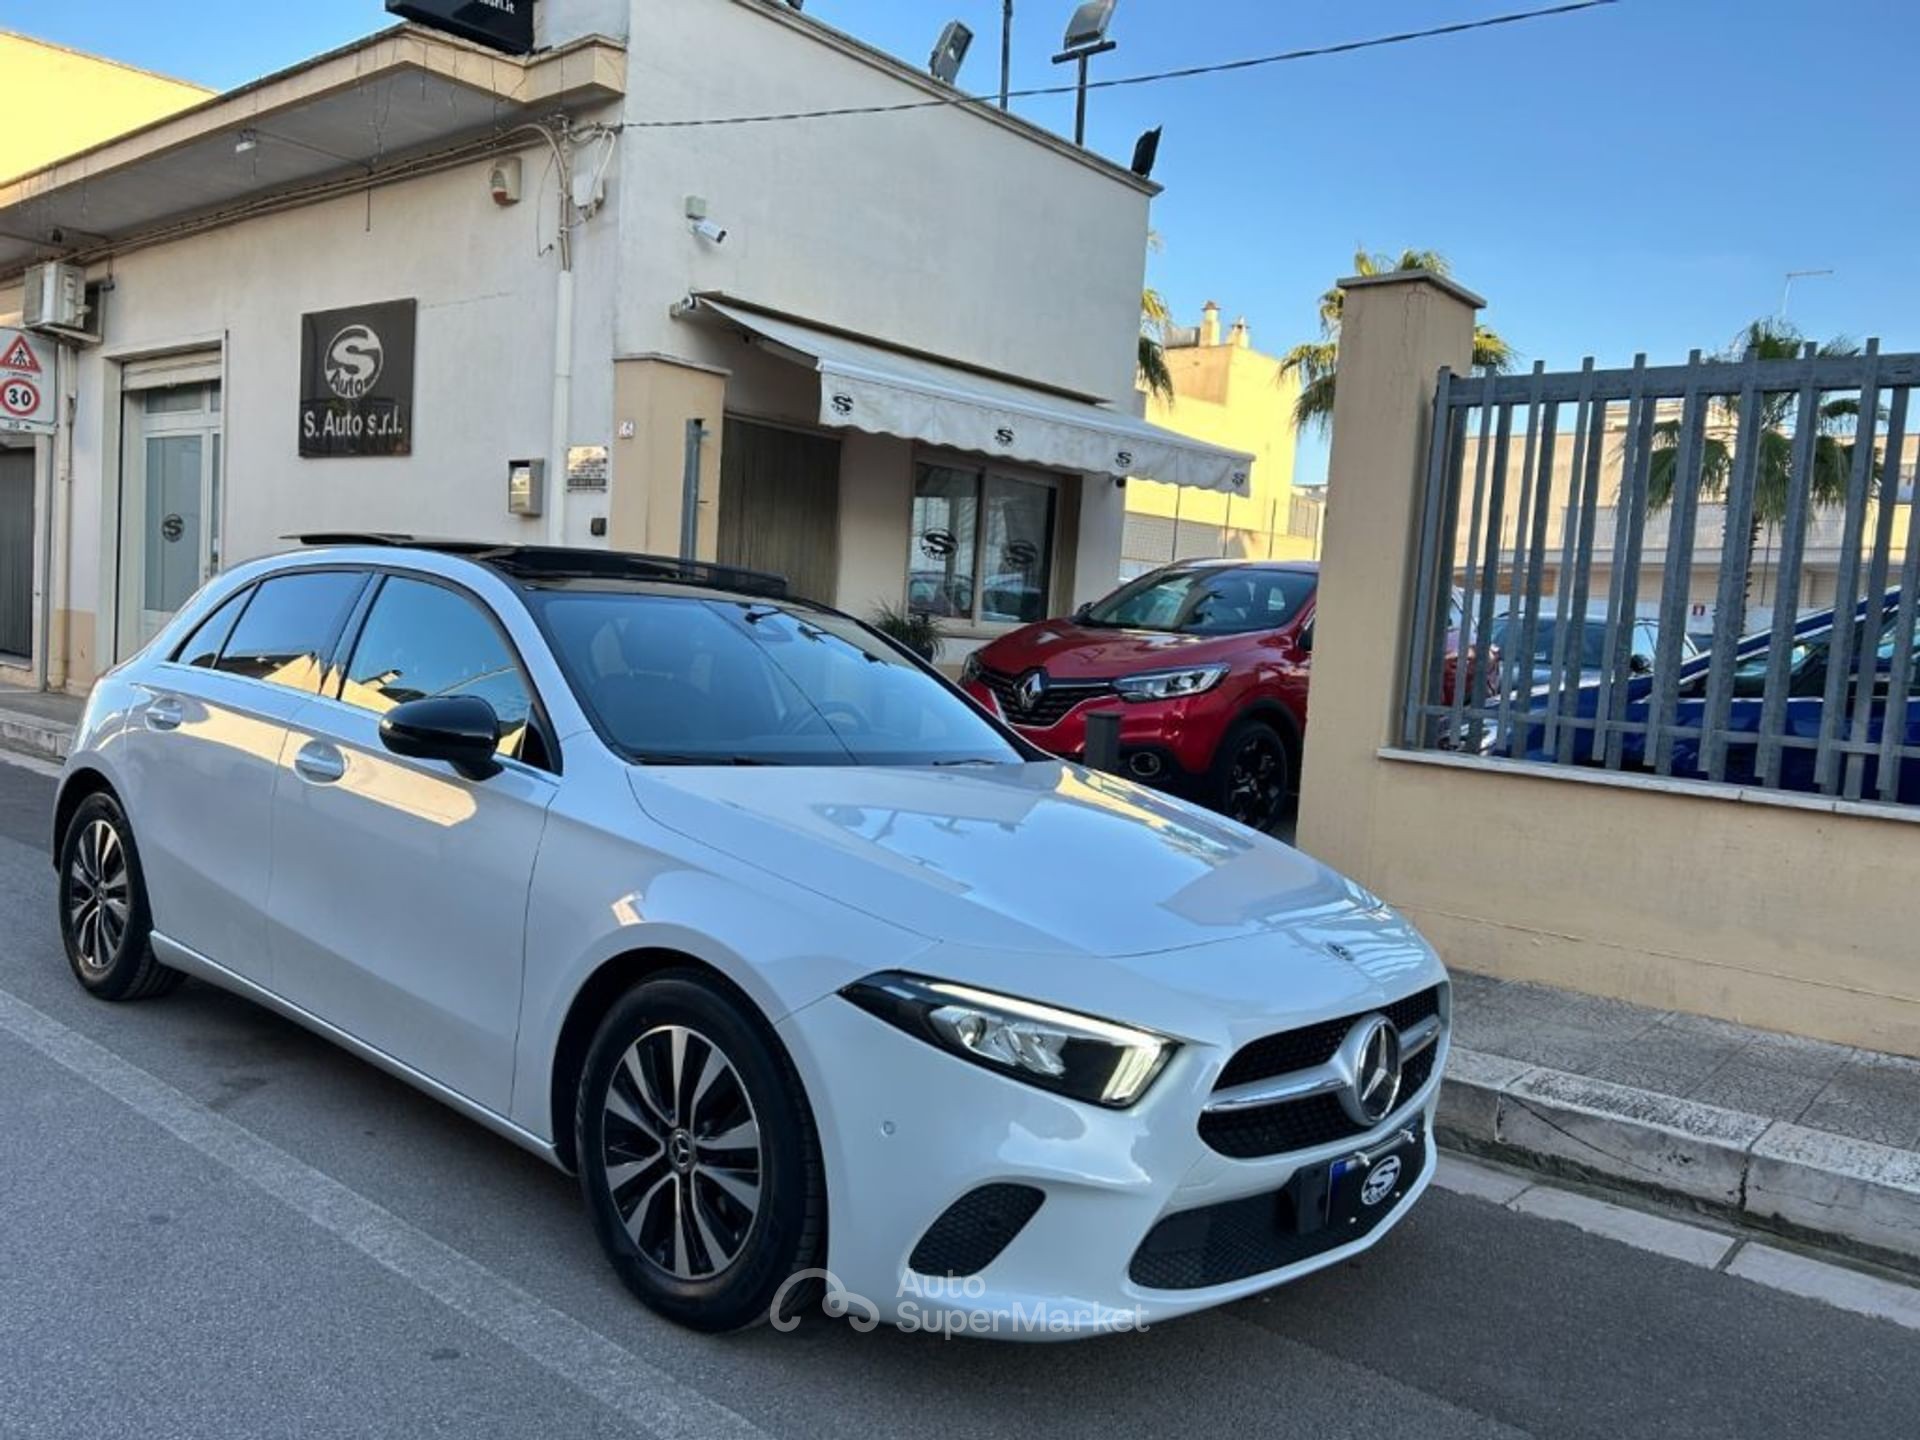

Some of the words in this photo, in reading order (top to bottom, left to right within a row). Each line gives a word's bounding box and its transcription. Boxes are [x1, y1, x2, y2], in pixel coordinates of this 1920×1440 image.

[9, 388, 31, 406] 30
[330, 368, 364, 397] Auto
[304, 410, 320, 437] S.
[322, 409, 363, 437] Auto
[366, 405, 403, 435] s.r.l.
